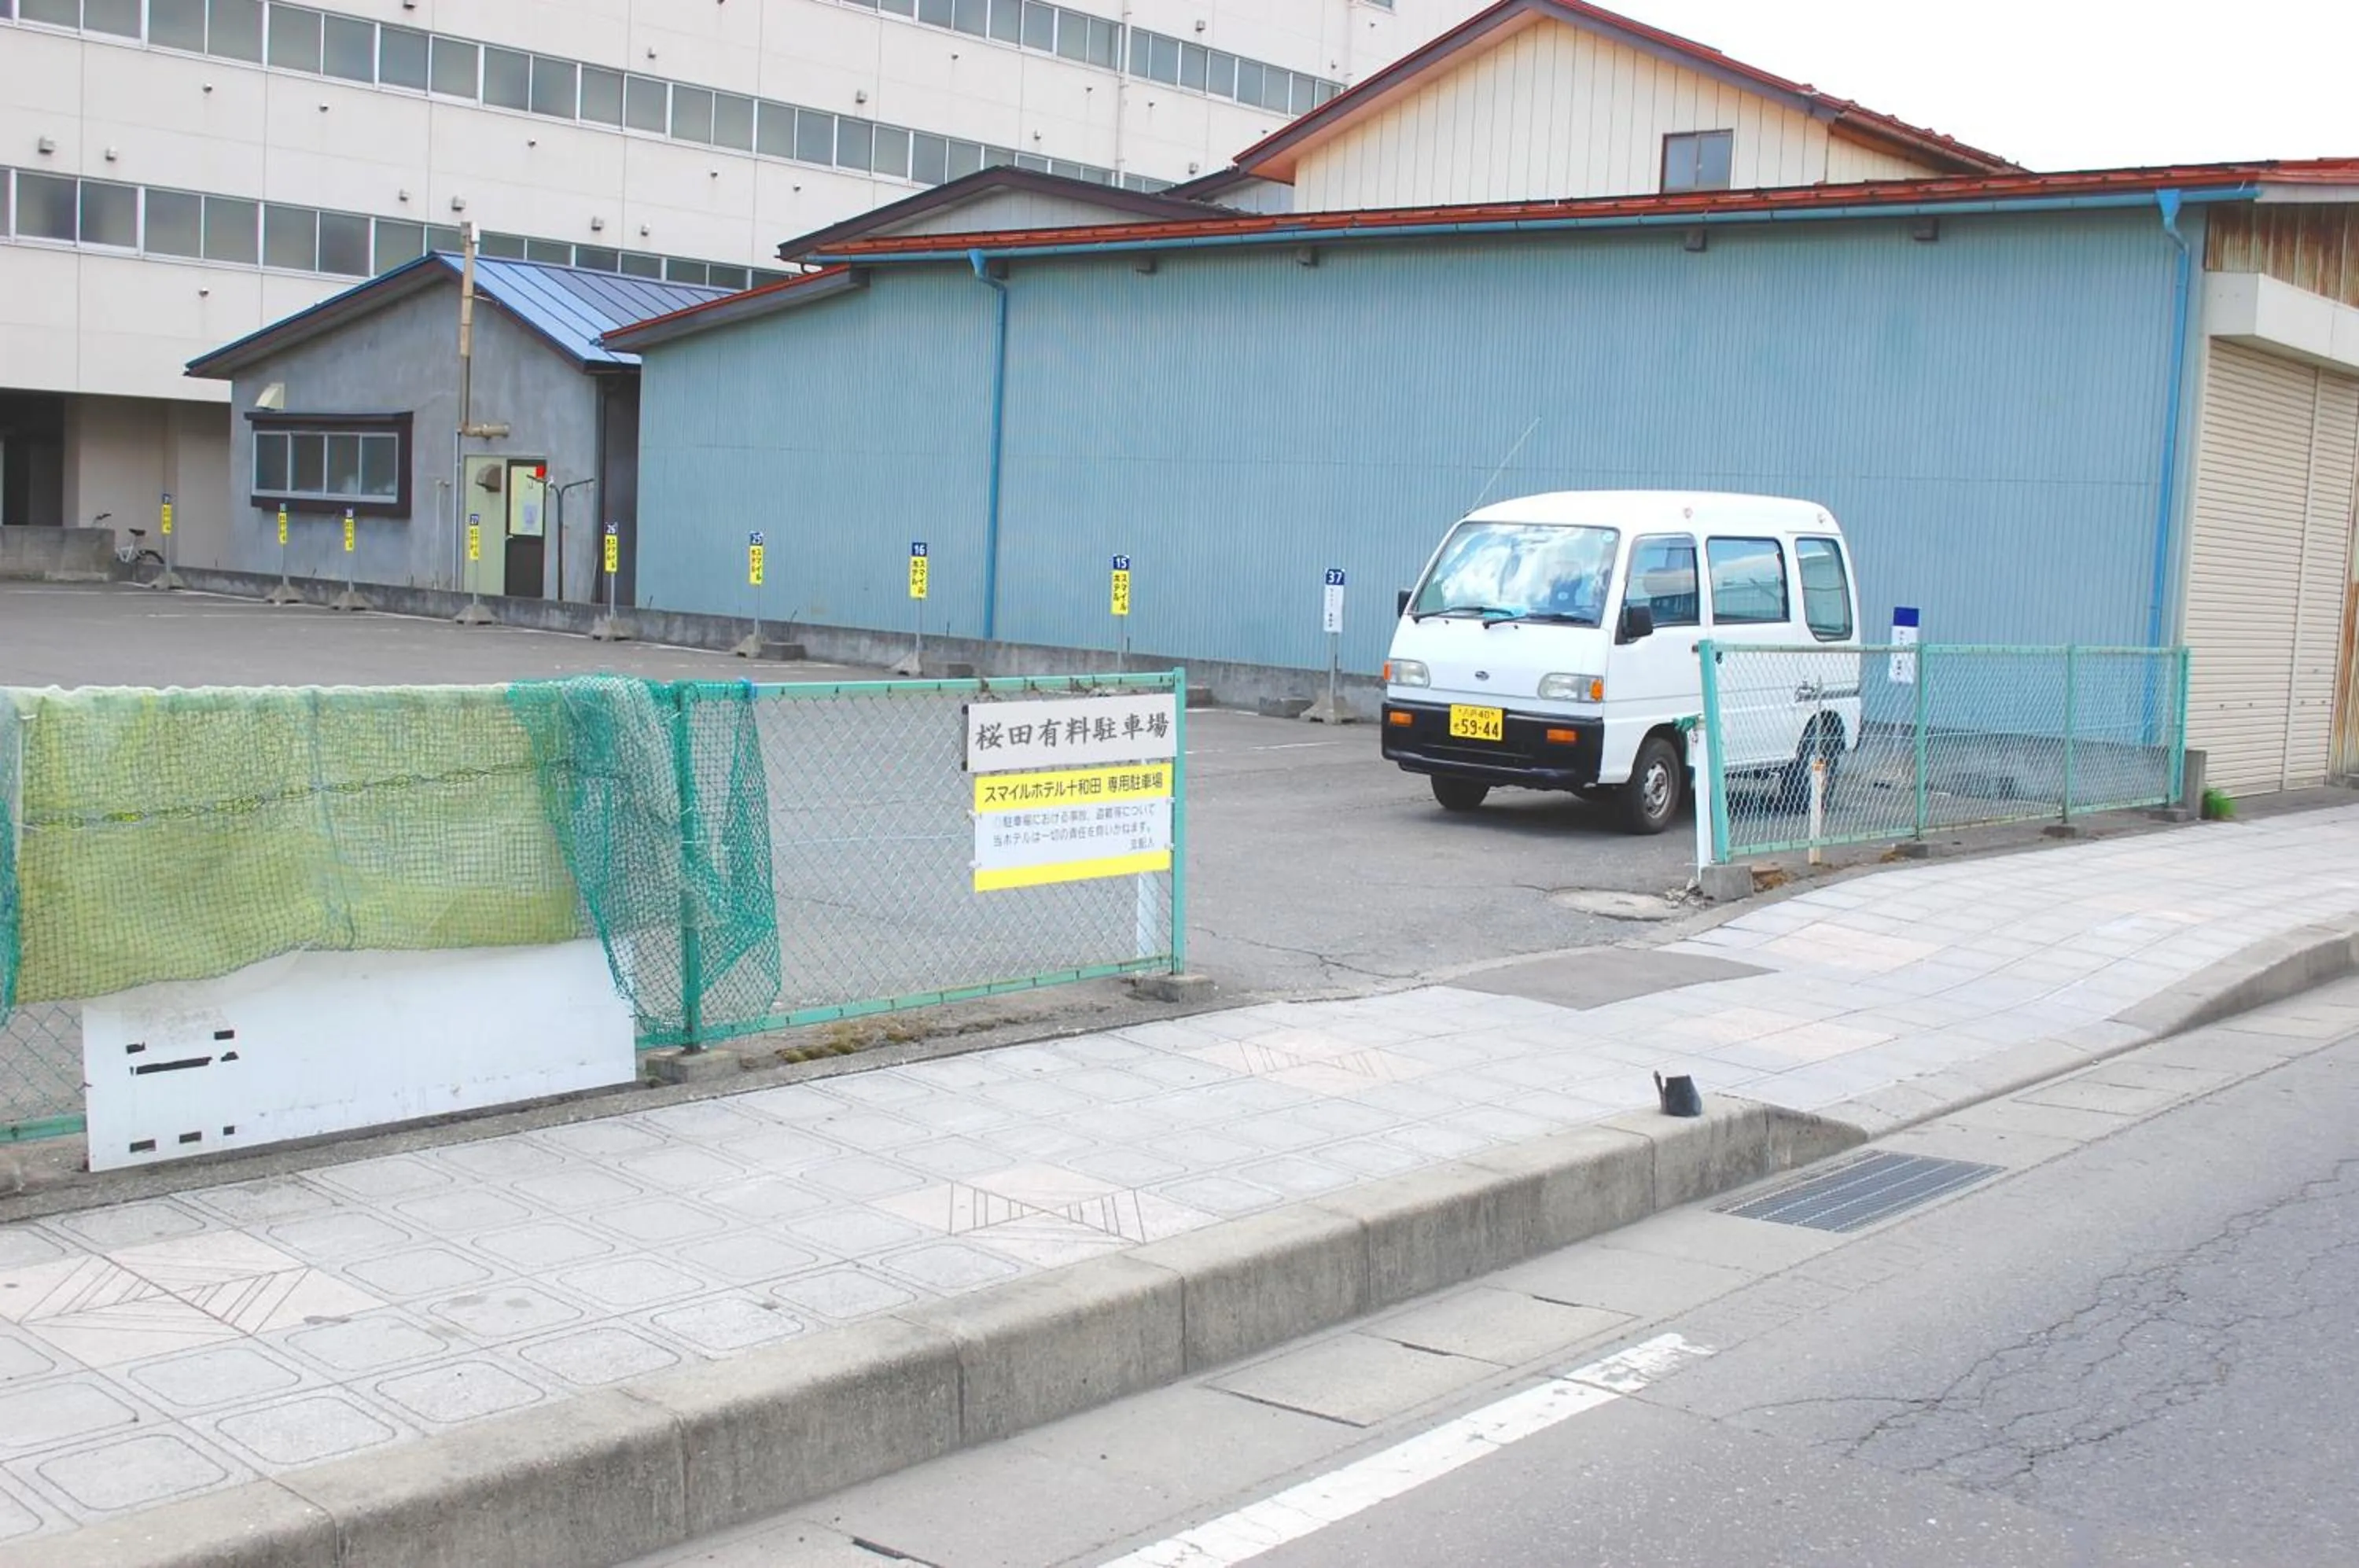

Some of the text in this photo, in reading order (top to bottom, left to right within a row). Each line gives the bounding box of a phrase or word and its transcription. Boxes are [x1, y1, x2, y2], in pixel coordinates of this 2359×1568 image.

[915, 545, 926, 554] 16
[1117, 558, 1127, 569] 15
[1328, 571, 1342, 583] 37
[975, 711, 1169, 751] 桜田有料駐車場
[984, 771, 1163, 803] スマイルホテル十和田 専用駐車場
